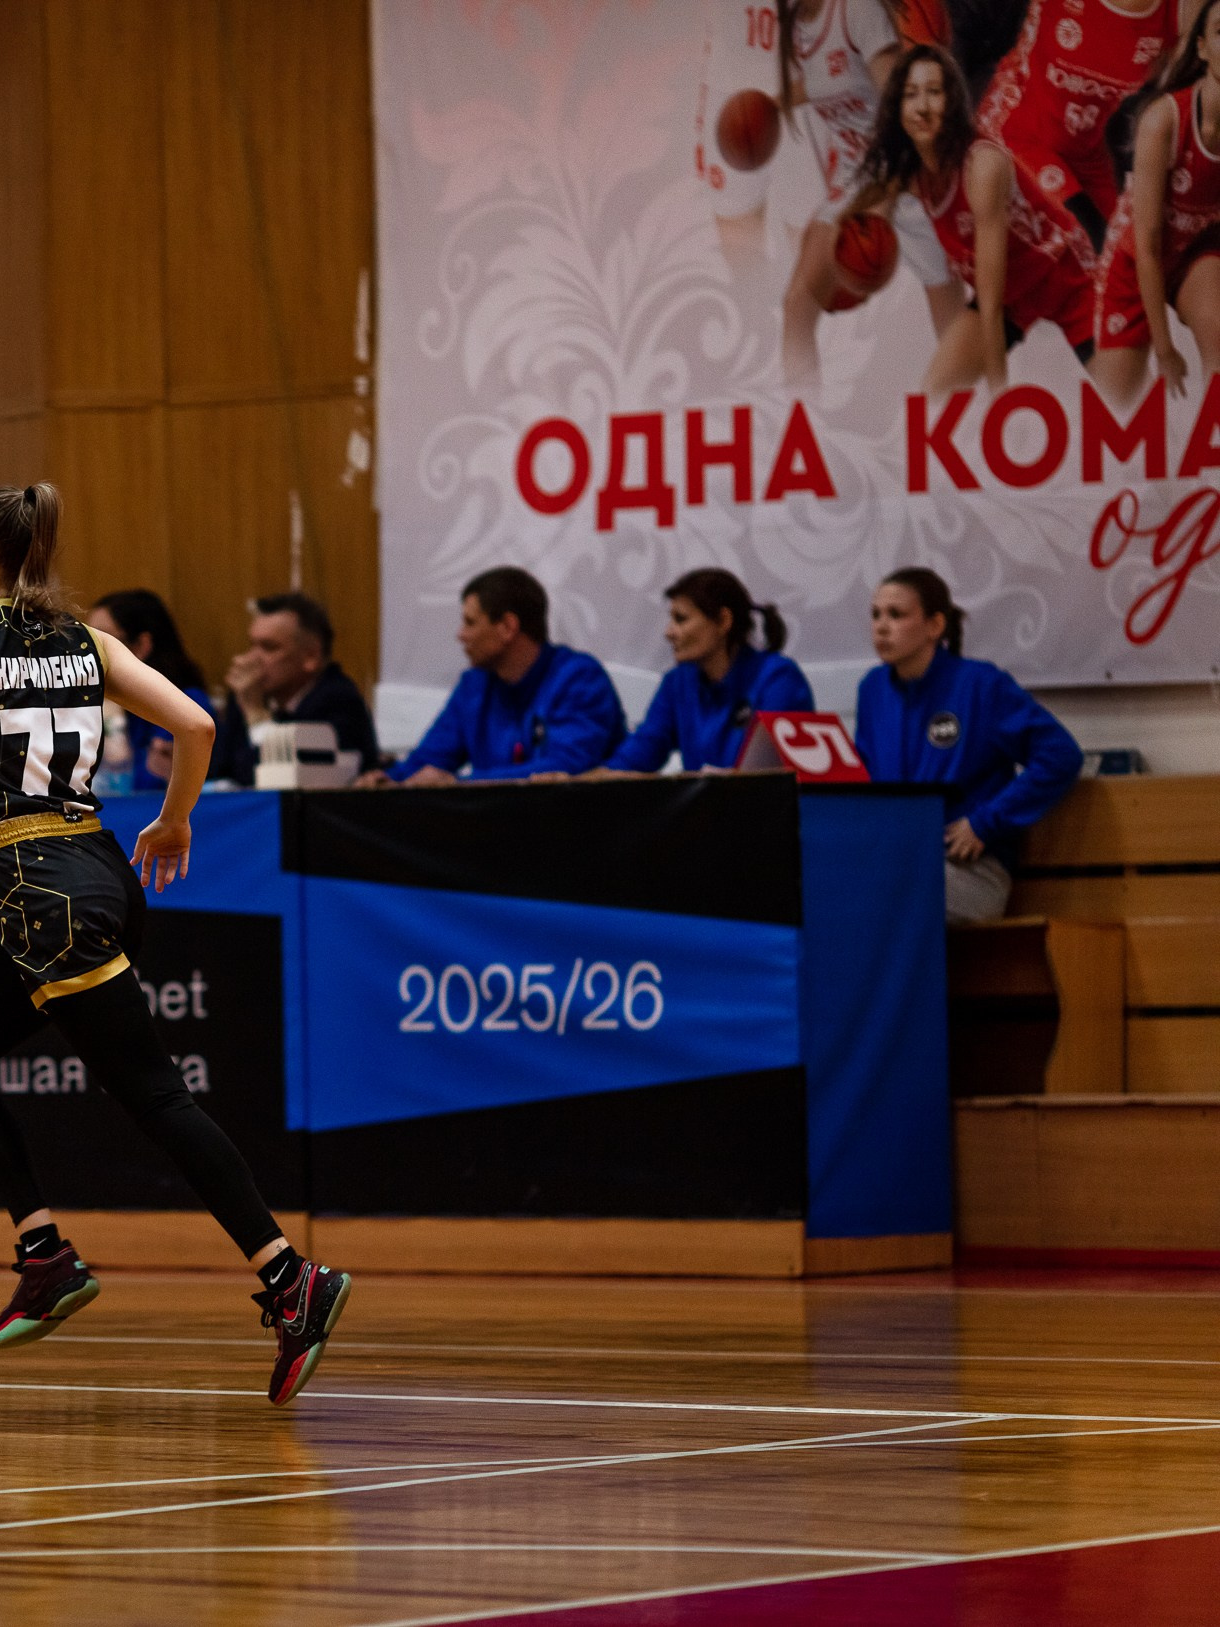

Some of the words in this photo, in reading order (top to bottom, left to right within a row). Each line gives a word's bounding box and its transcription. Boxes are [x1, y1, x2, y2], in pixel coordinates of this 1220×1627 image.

[515, 400, 837, 532] ОДНА
[0, 705, 102, 796] 77
[398, 958, 665, 1036] 2025/26
